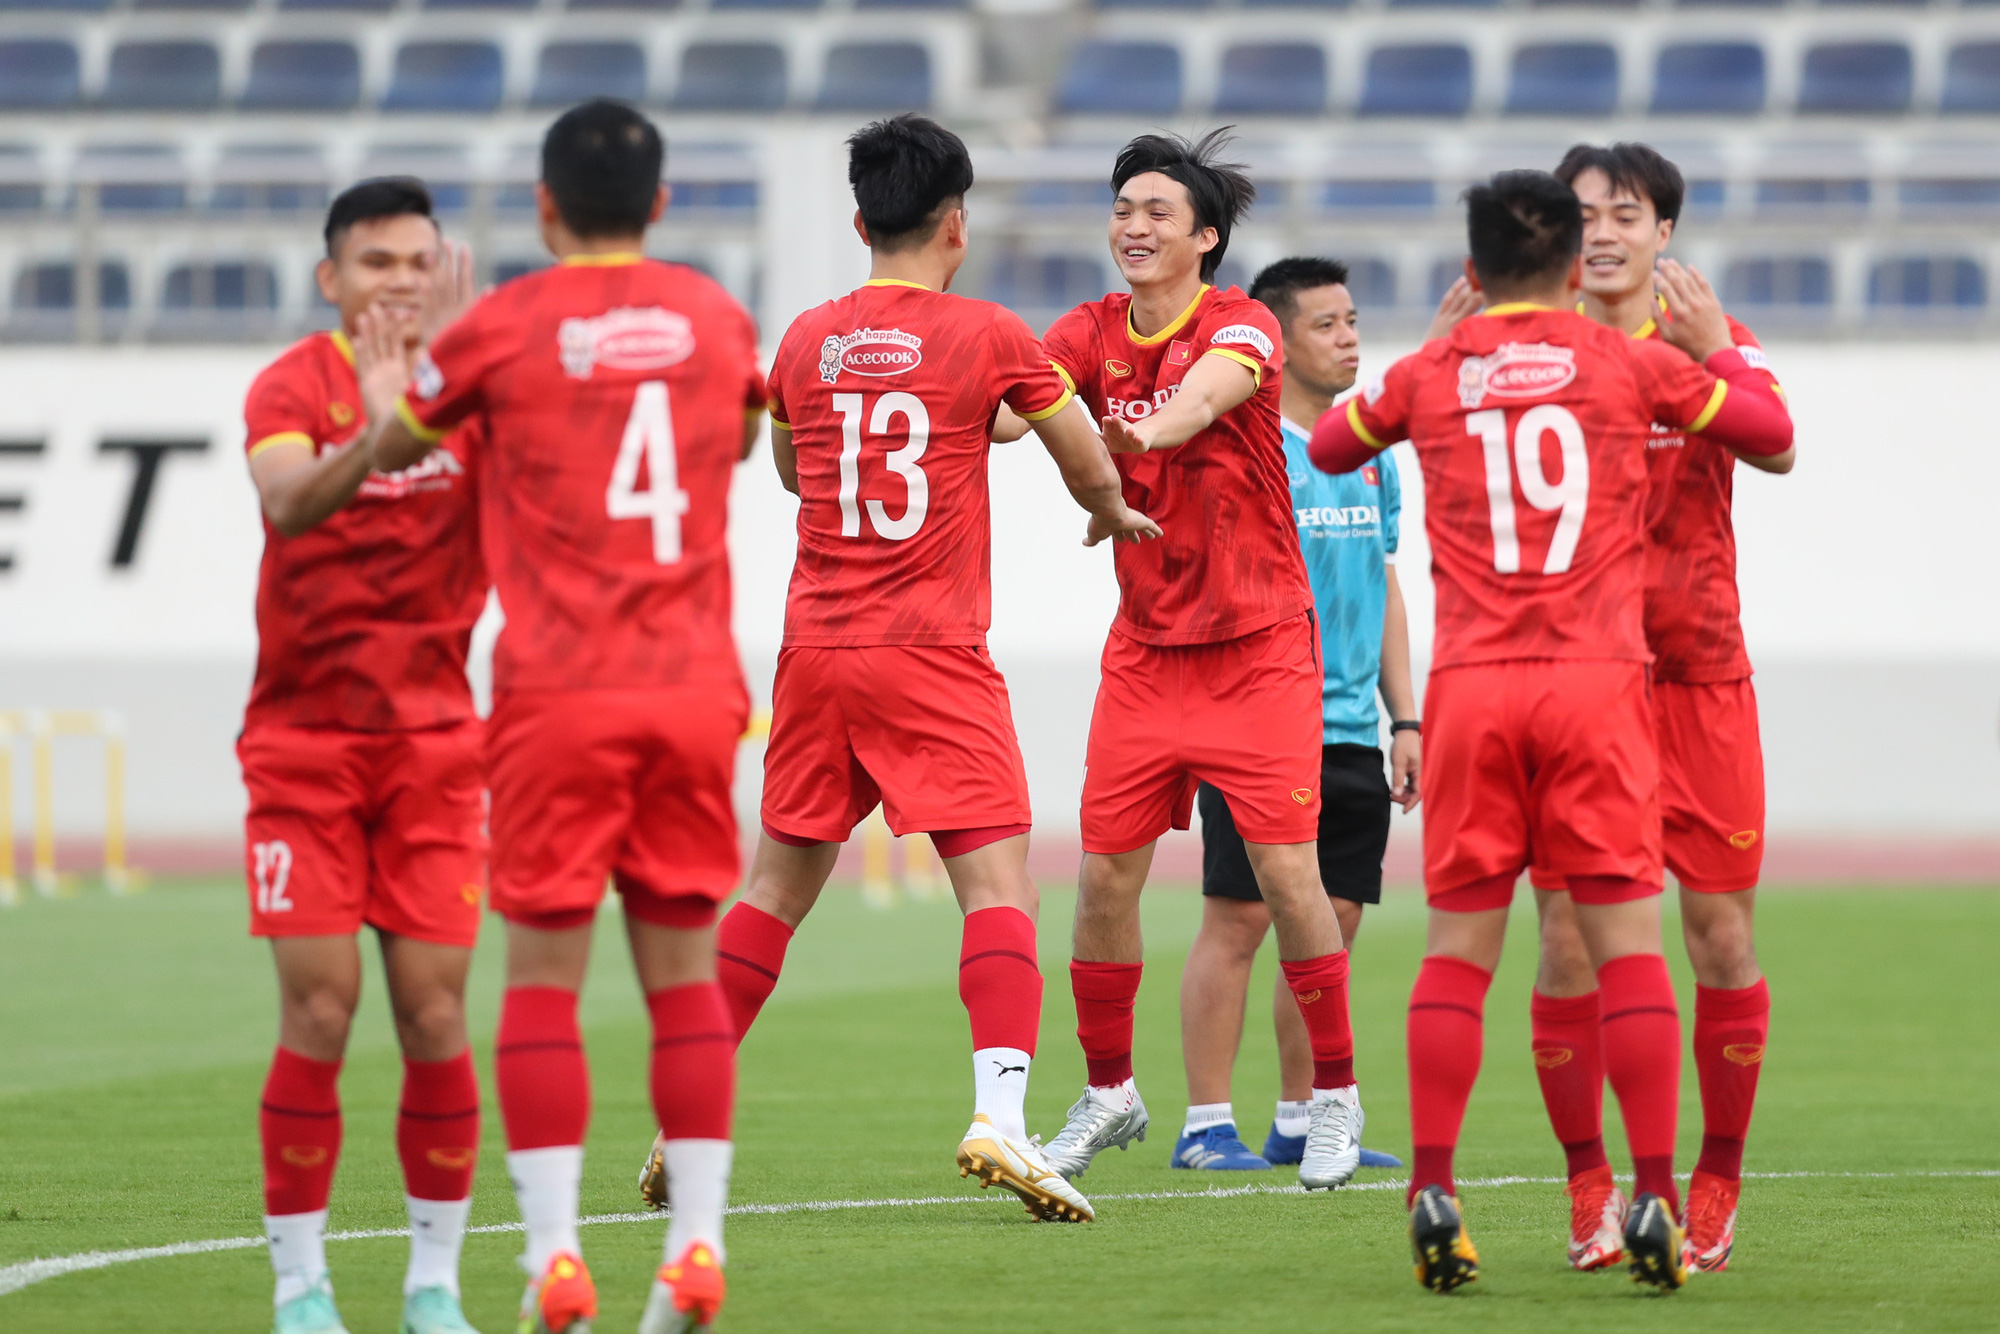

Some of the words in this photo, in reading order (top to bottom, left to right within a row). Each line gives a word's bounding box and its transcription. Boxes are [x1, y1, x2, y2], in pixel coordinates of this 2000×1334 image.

[842, 331, 863, 347] Cook
[866, 328, 919, 346] happiness
[1107, 384, 1181, 419] HODA
[605, 380, 690, 564] 4
[832, 391, 930, 540] 13
[1466, 404, 1590, 575] 19
[1295, 506, 1381, 527] HONDA
[253, 840, 294, 913] 12
